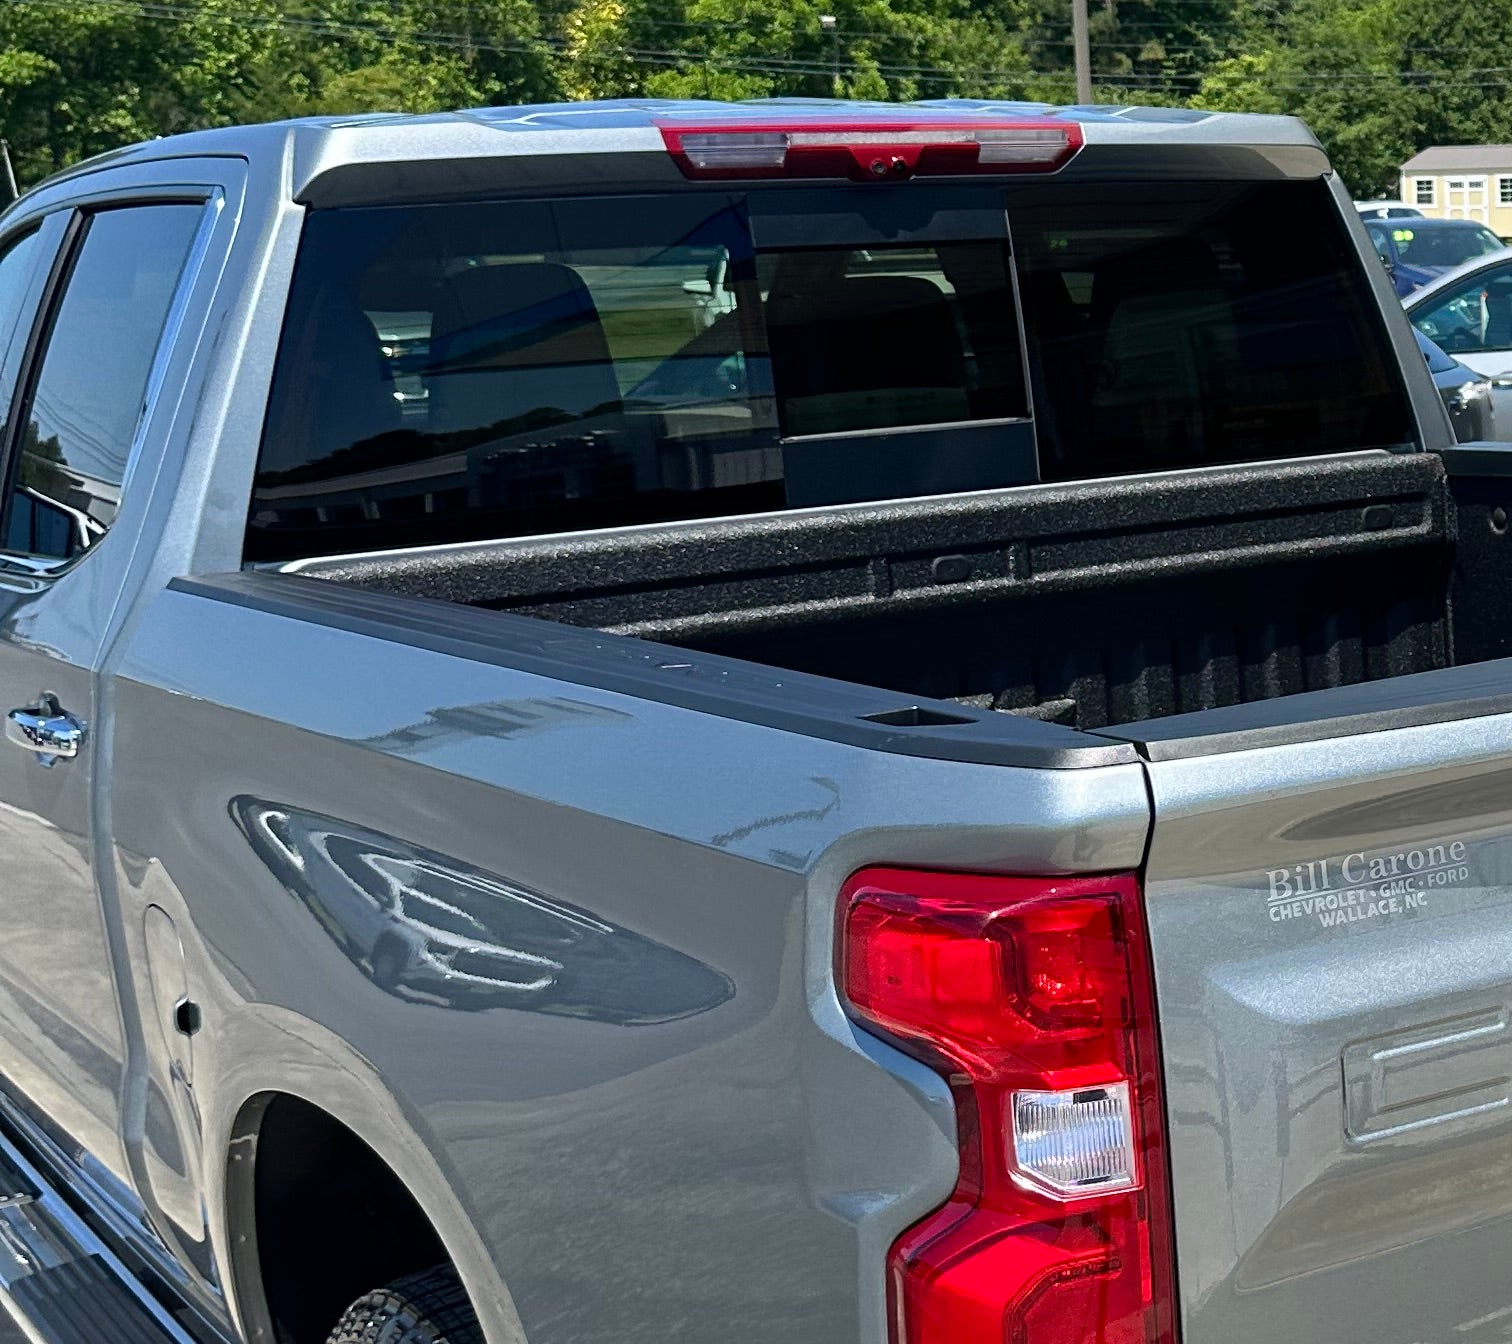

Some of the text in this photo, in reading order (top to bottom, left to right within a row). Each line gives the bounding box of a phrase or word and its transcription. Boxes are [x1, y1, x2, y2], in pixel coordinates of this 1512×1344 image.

[1266, 841, 1467, 901] Bill Carone
[1269, 867, 1469, 922] CHEVROLET GMC FORD
[1318, 891, 1428, 928] WALLACE, NC
